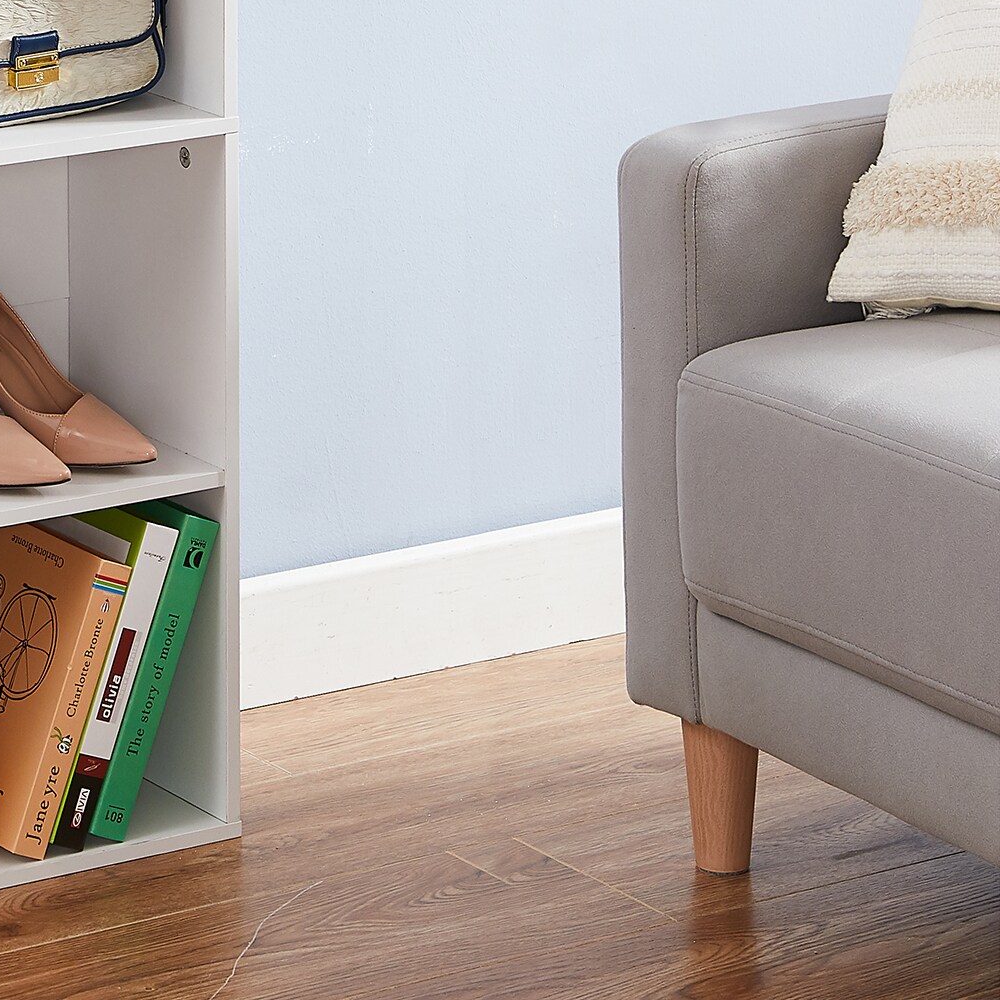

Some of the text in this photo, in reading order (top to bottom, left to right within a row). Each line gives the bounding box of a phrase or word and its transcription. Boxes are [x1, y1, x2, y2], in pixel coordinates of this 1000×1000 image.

[11, 534, 65, 569] Charlotte Bronte
[66, 618, 104, 718] Charlotte Bronte
[101, 674, 122, 719] olivia
[126, 613, 180, 757] The story of model
[25, 765, 60, 845] Jane yre
[104, 810, 124, 824] 801
